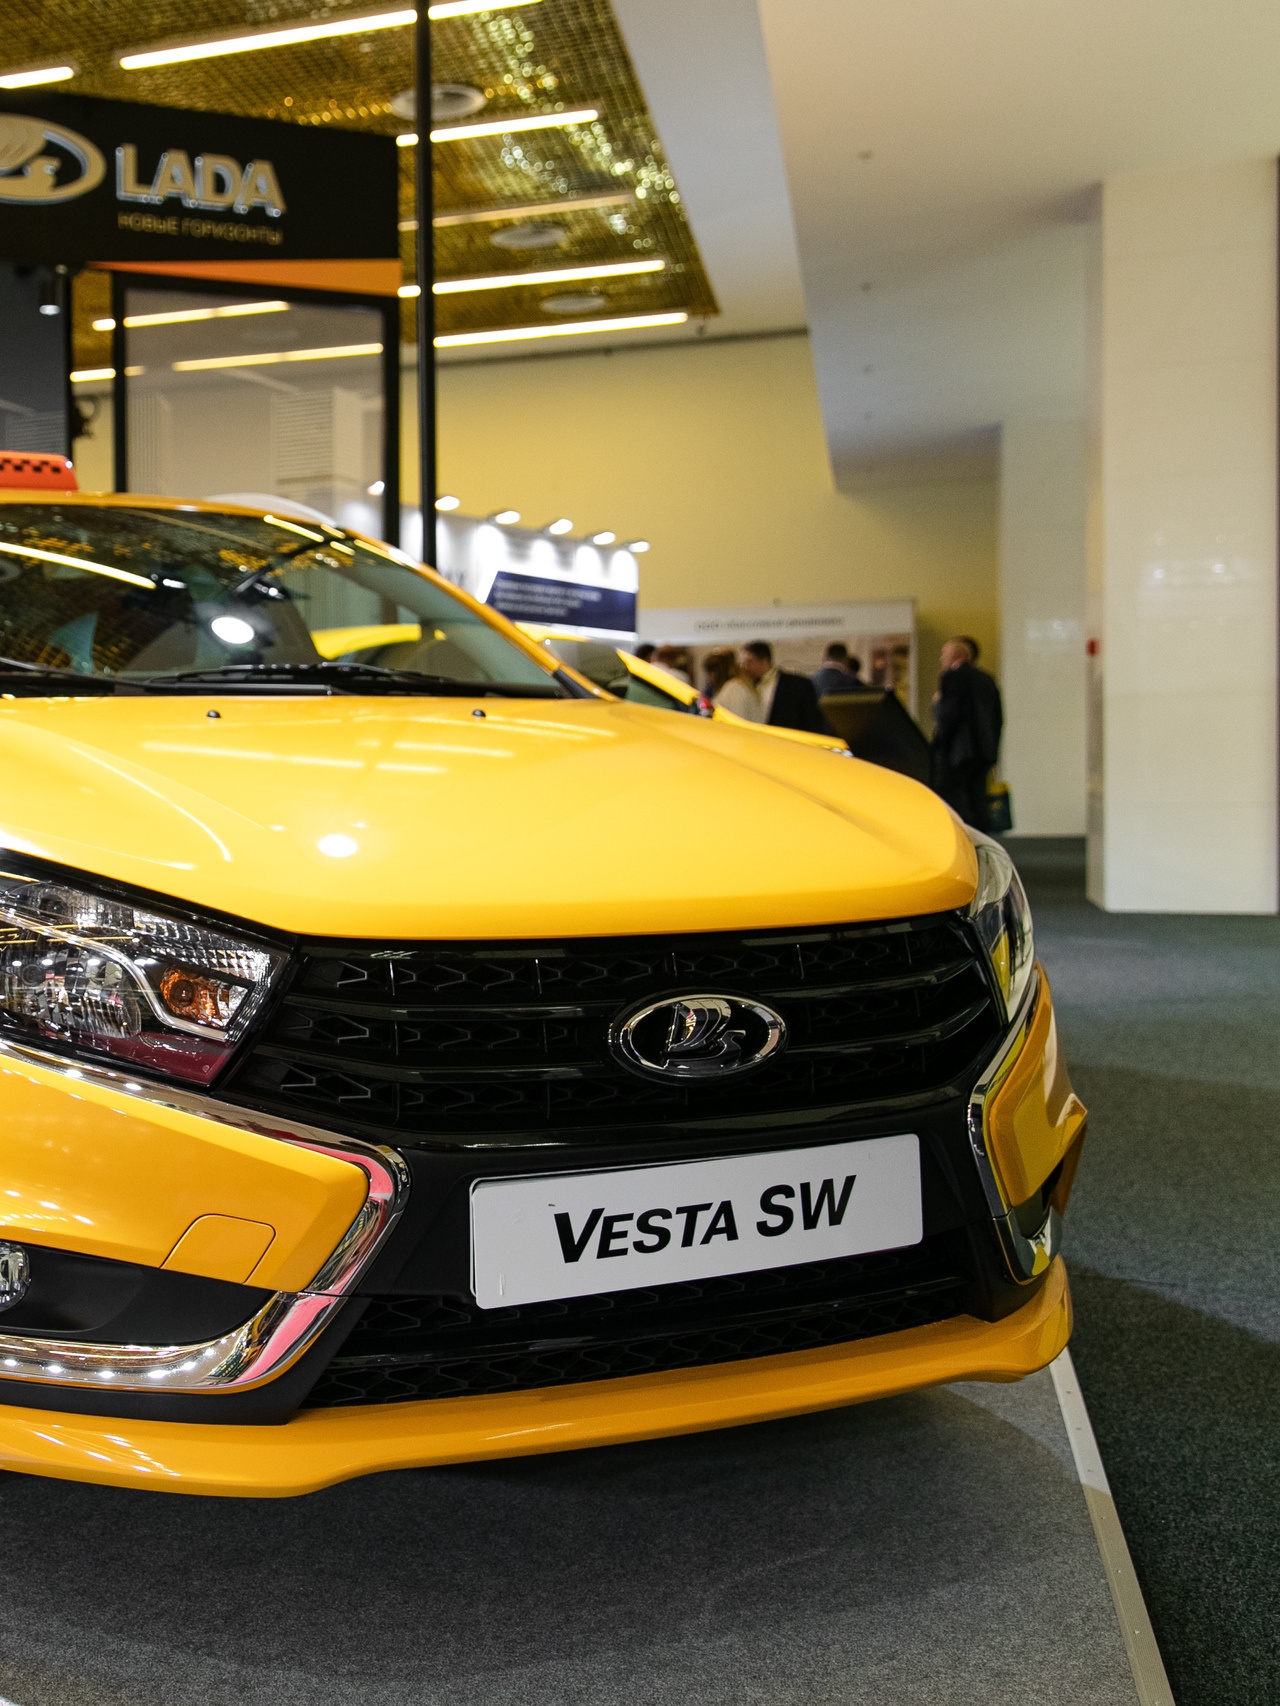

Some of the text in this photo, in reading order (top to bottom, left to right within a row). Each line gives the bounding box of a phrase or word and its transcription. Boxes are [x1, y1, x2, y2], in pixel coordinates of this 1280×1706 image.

[115, 142, 287, 218] LADA
[118, 210, 284, 246] НОВЫЕ ГОРИЗОНТЫ
[553, 1174, 858, 1264] VESTA SW
